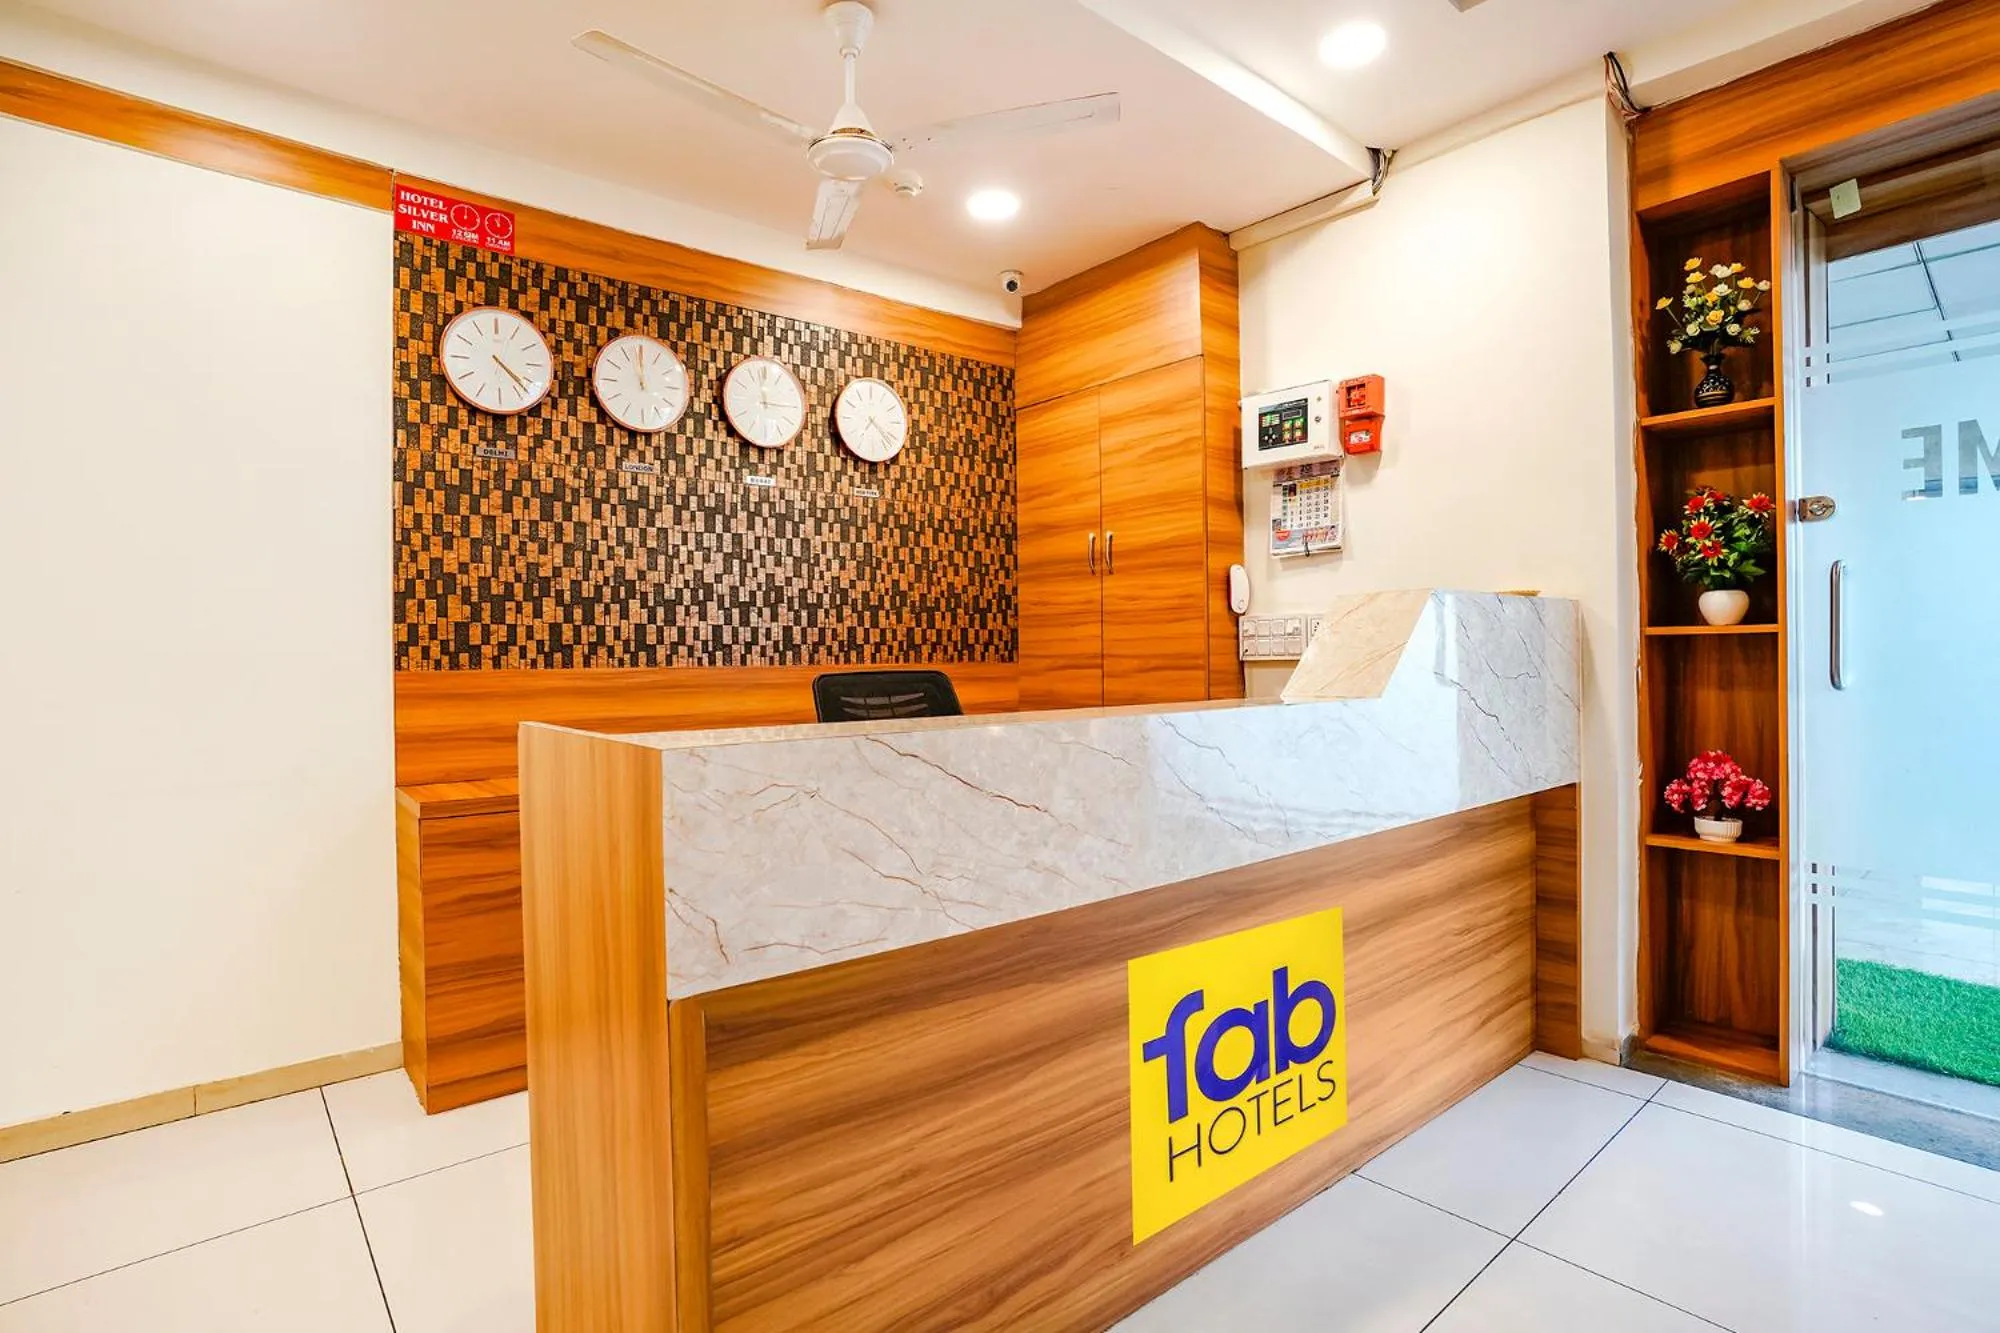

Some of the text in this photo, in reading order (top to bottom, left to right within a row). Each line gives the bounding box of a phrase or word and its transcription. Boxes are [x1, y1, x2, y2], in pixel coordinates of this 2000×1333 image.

[400, 190, 447, 210] HOTEL
[398, 204, 449, 224] SILVER
[412, 219, 436, 233] INN
[625, 463, 653, 472] LONDON
[1142, 965, 1337, 1125] fab
[1169, 1060, 1337, 1182] HOTELS
